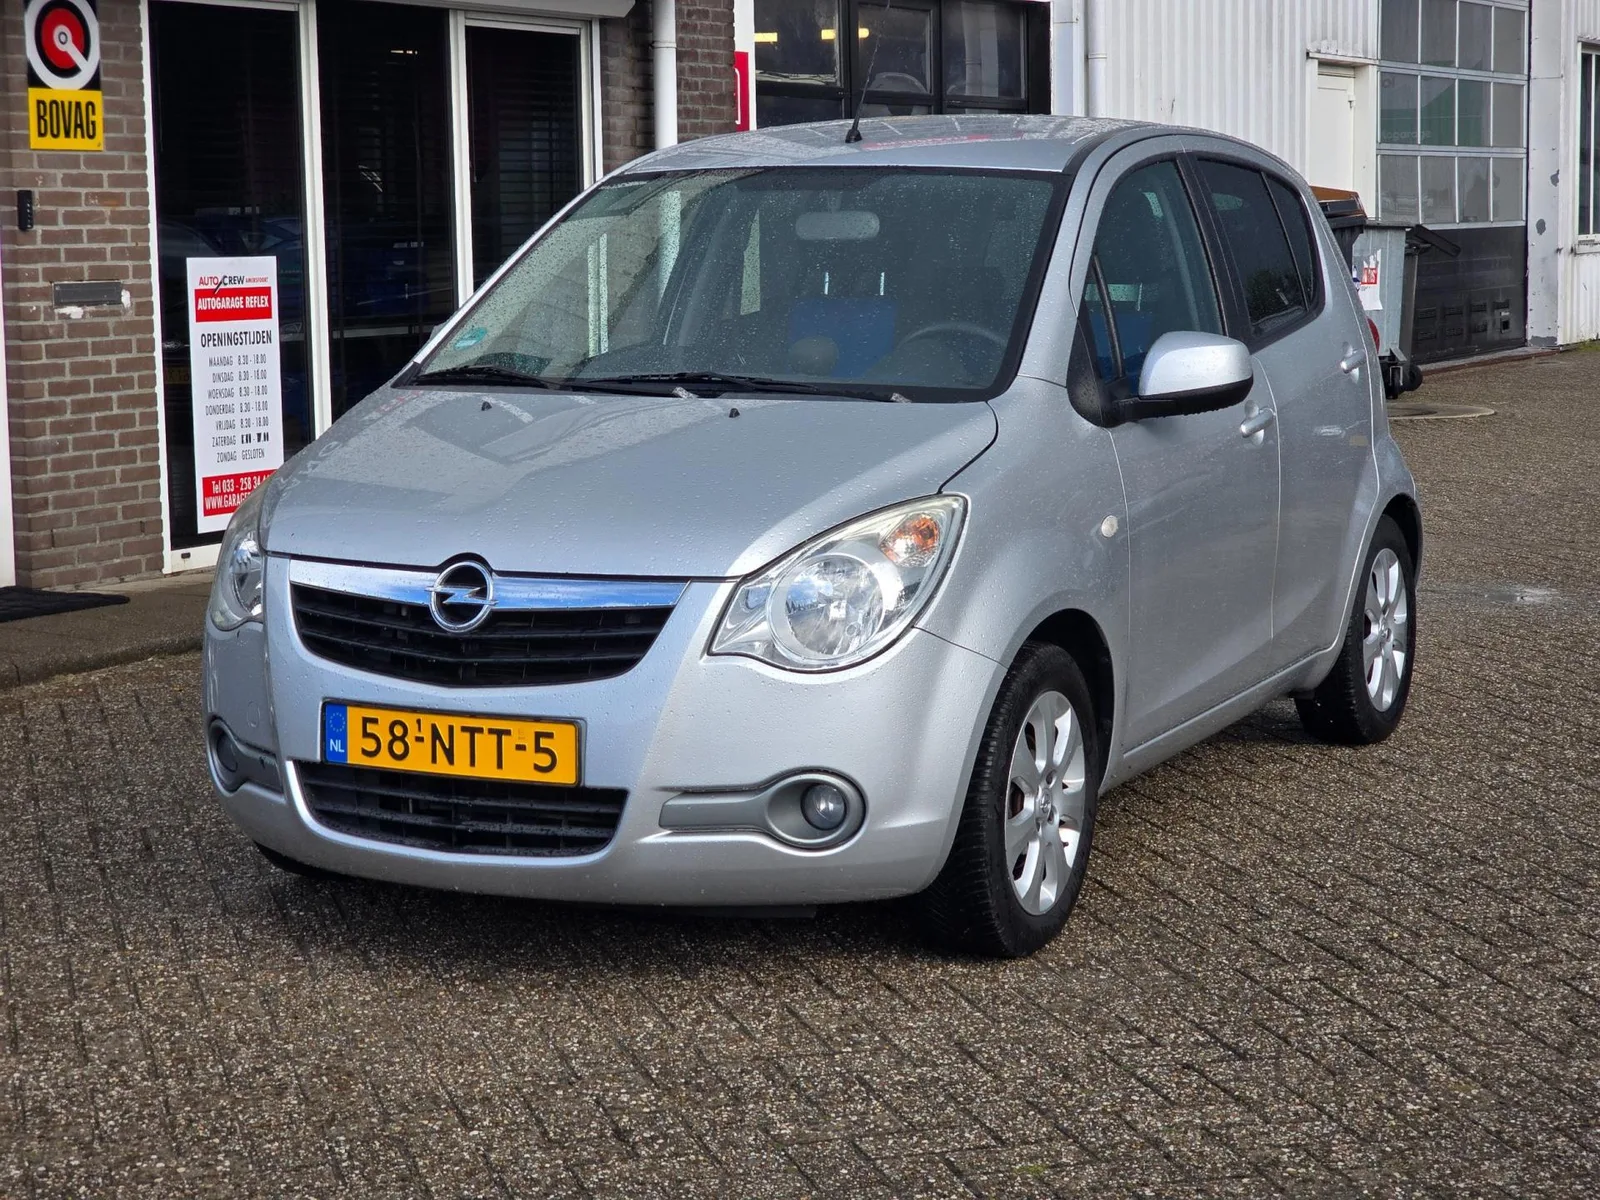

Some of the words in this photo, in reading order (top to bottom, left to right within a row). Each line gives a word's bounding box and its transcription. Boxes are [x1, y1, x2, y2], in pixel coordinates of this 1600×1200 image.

[36, 99, 96, 140] BOVAG
[199, 276, 219, 286] AUTO
[222, 275, 245, 285] CREW
[197, 296, 244, 310] AUTOGARAGE
[245, 295, 269, 308] REFLEX
[201, 330, 272, 347] OPENINGSTIJDEN
[209, 356, 233, 367] MAANDAG
[213, 372, 234, 383] DINSDAG
[208, 388, 234, 399] WOENSDAG
[206, 404, 235, 415] DONDERDAG
[216, 420, 235, 430] VRIJDAG
[212, 435, 237, 447] ZATERDAG
[217, 451, 237, 463] ZONDAG
[241, 448, 265, 460] GESLOTEN
[212, 480, 221, 494] Tel
[222, 478, 235, 493] 033
[239, 477, 252, 491] 258
[329, 738, 345, 753] NL
[360, 716, 559, 774] 58-NTT-5
